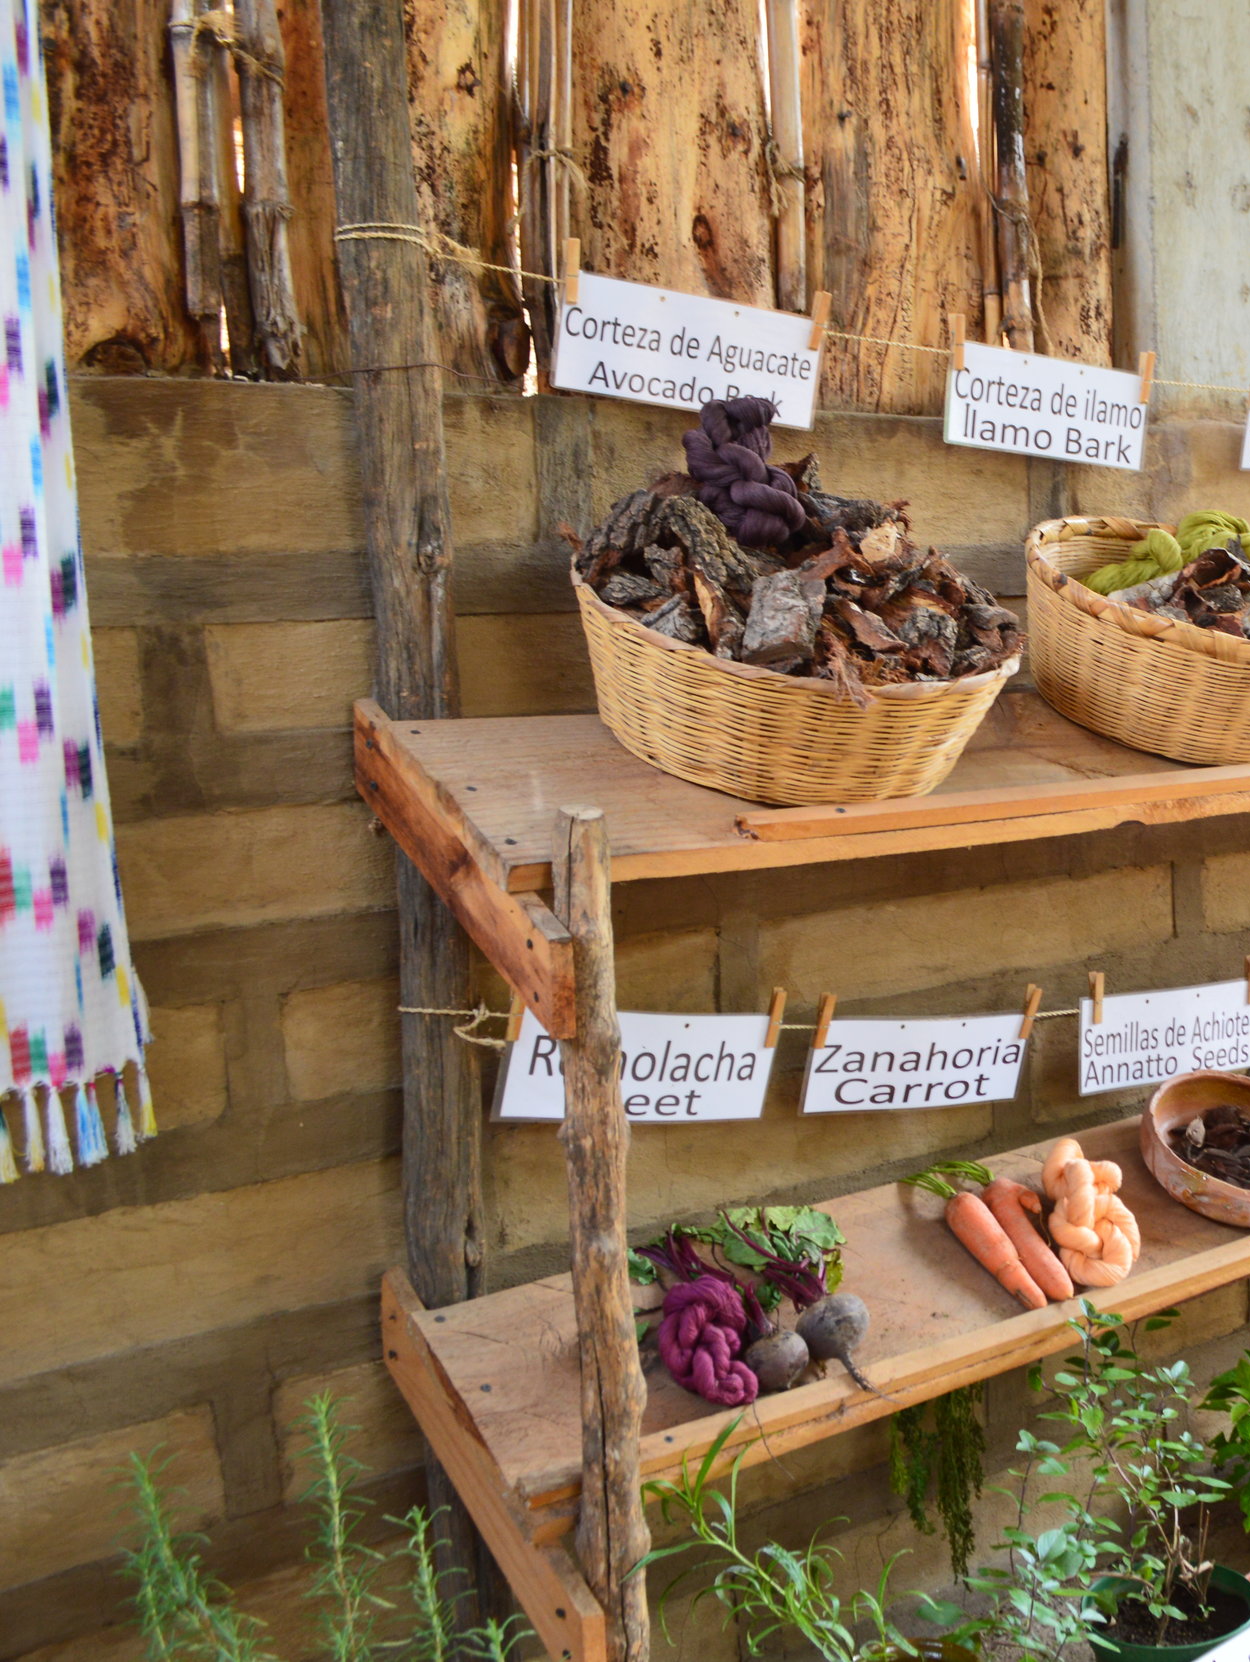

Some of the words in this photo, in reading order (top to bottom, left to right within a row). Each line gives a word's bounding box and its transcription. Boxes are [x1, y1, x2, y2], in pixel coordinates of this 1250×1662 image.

[565, 307, 660, 352] Corteza
[670, 327, 700, 359] de
[706, 335, 812, 380] Aguacate
[588, 361, 714, 405] Avocado
[955, 367, 1042, 412] Corteza
[1050, 383, 1077, 418] de
[1084, 388, 1142, 429] ilamo
[1065, 428, 1132, 464] Bark
[814, 1038, 1021, 1074] Zanahoria
[1084, 1021, 1159, 1058] Semillas
[1165, 1017, 1186, 1047] de
[1191, 1010, 1250, 1044] Achiote
[528, 1035, 756, 1082] Rolacha
[1084, 1053, 1178, 1088] Annatto
[1191, 1038, 1249, 1072] Seeds
[624, 1090, 702, 1116] eet
[834, 1074, 990, 1105] Carrot
